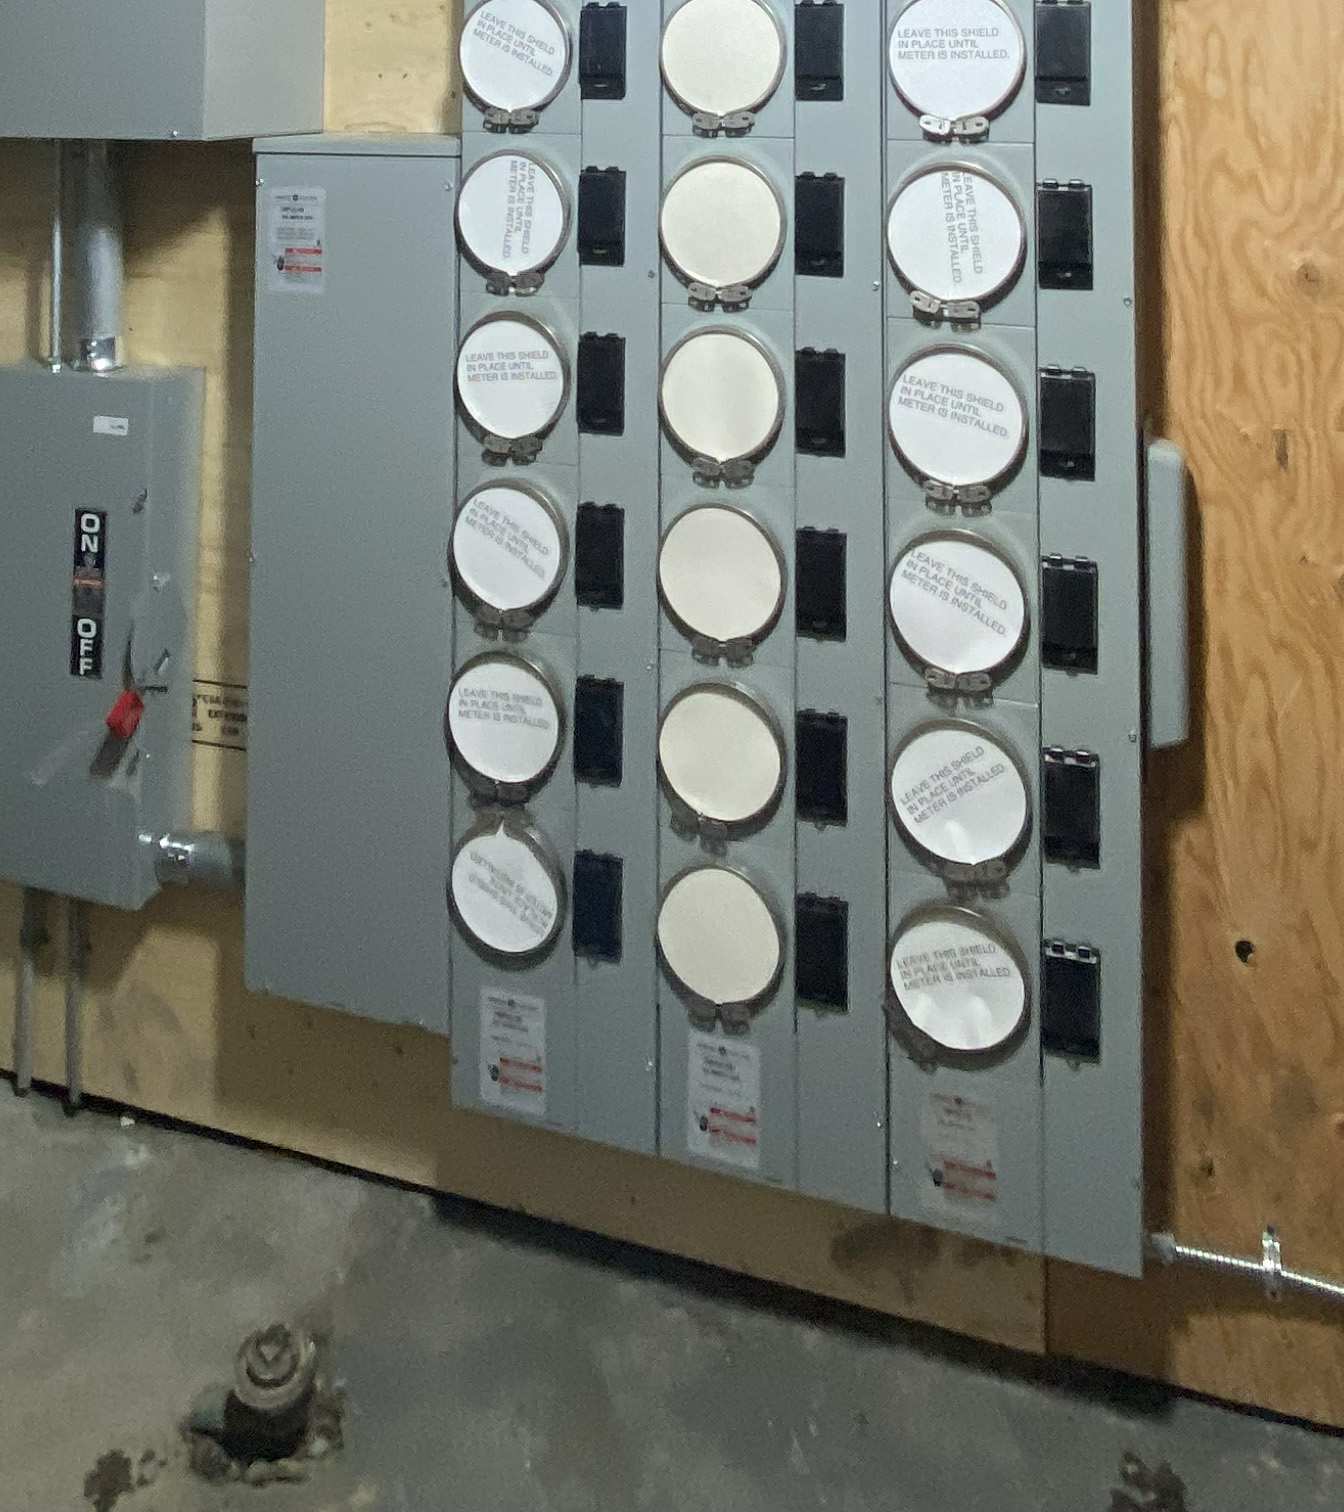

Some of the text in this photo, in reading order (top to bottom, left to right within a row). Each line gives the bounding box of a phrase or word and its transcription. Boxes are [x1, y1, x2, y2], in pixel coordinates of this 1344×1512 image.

[898, 28, 998, 38] LEAVE THIS SHIELD
[898, 40, 979, 48] IN PLACE UNTIL
[898, 50, 935, 60] METER
[938, 50, 947, 59] IS
[946, 212, 954, 222] IS
[954, 186, 965, 220] PLACE
[958, 222, 968, 254] UNTIL
[963, 172, 982, 274] EAVE THIS SHIELD
[466, 350, 549, 362] LEAVE THIS SHIELD
[478, 362, 506, 372] PLACE
[508, 362, 534, 370] UNTIL
[467, 372, 498, 382] METER
[898, 396, 935, 412] METER
[938, 408, 948, 417] IS
[901, 386, 981, 417] IN PLACE UNTIL
[903, 375, 1004, 412] LEAVE THIS SHIELD
[80, 513, 100, 553] ON
[902, 569, 938, 595] METER
[939, 590, 949, 600] IS
[906, 560, 982, 608] IN PLACE UNTIL
[911, 549, 1006, 610] LEAVE THIS SHIELD
[77, 618, 97, 676] OFF
